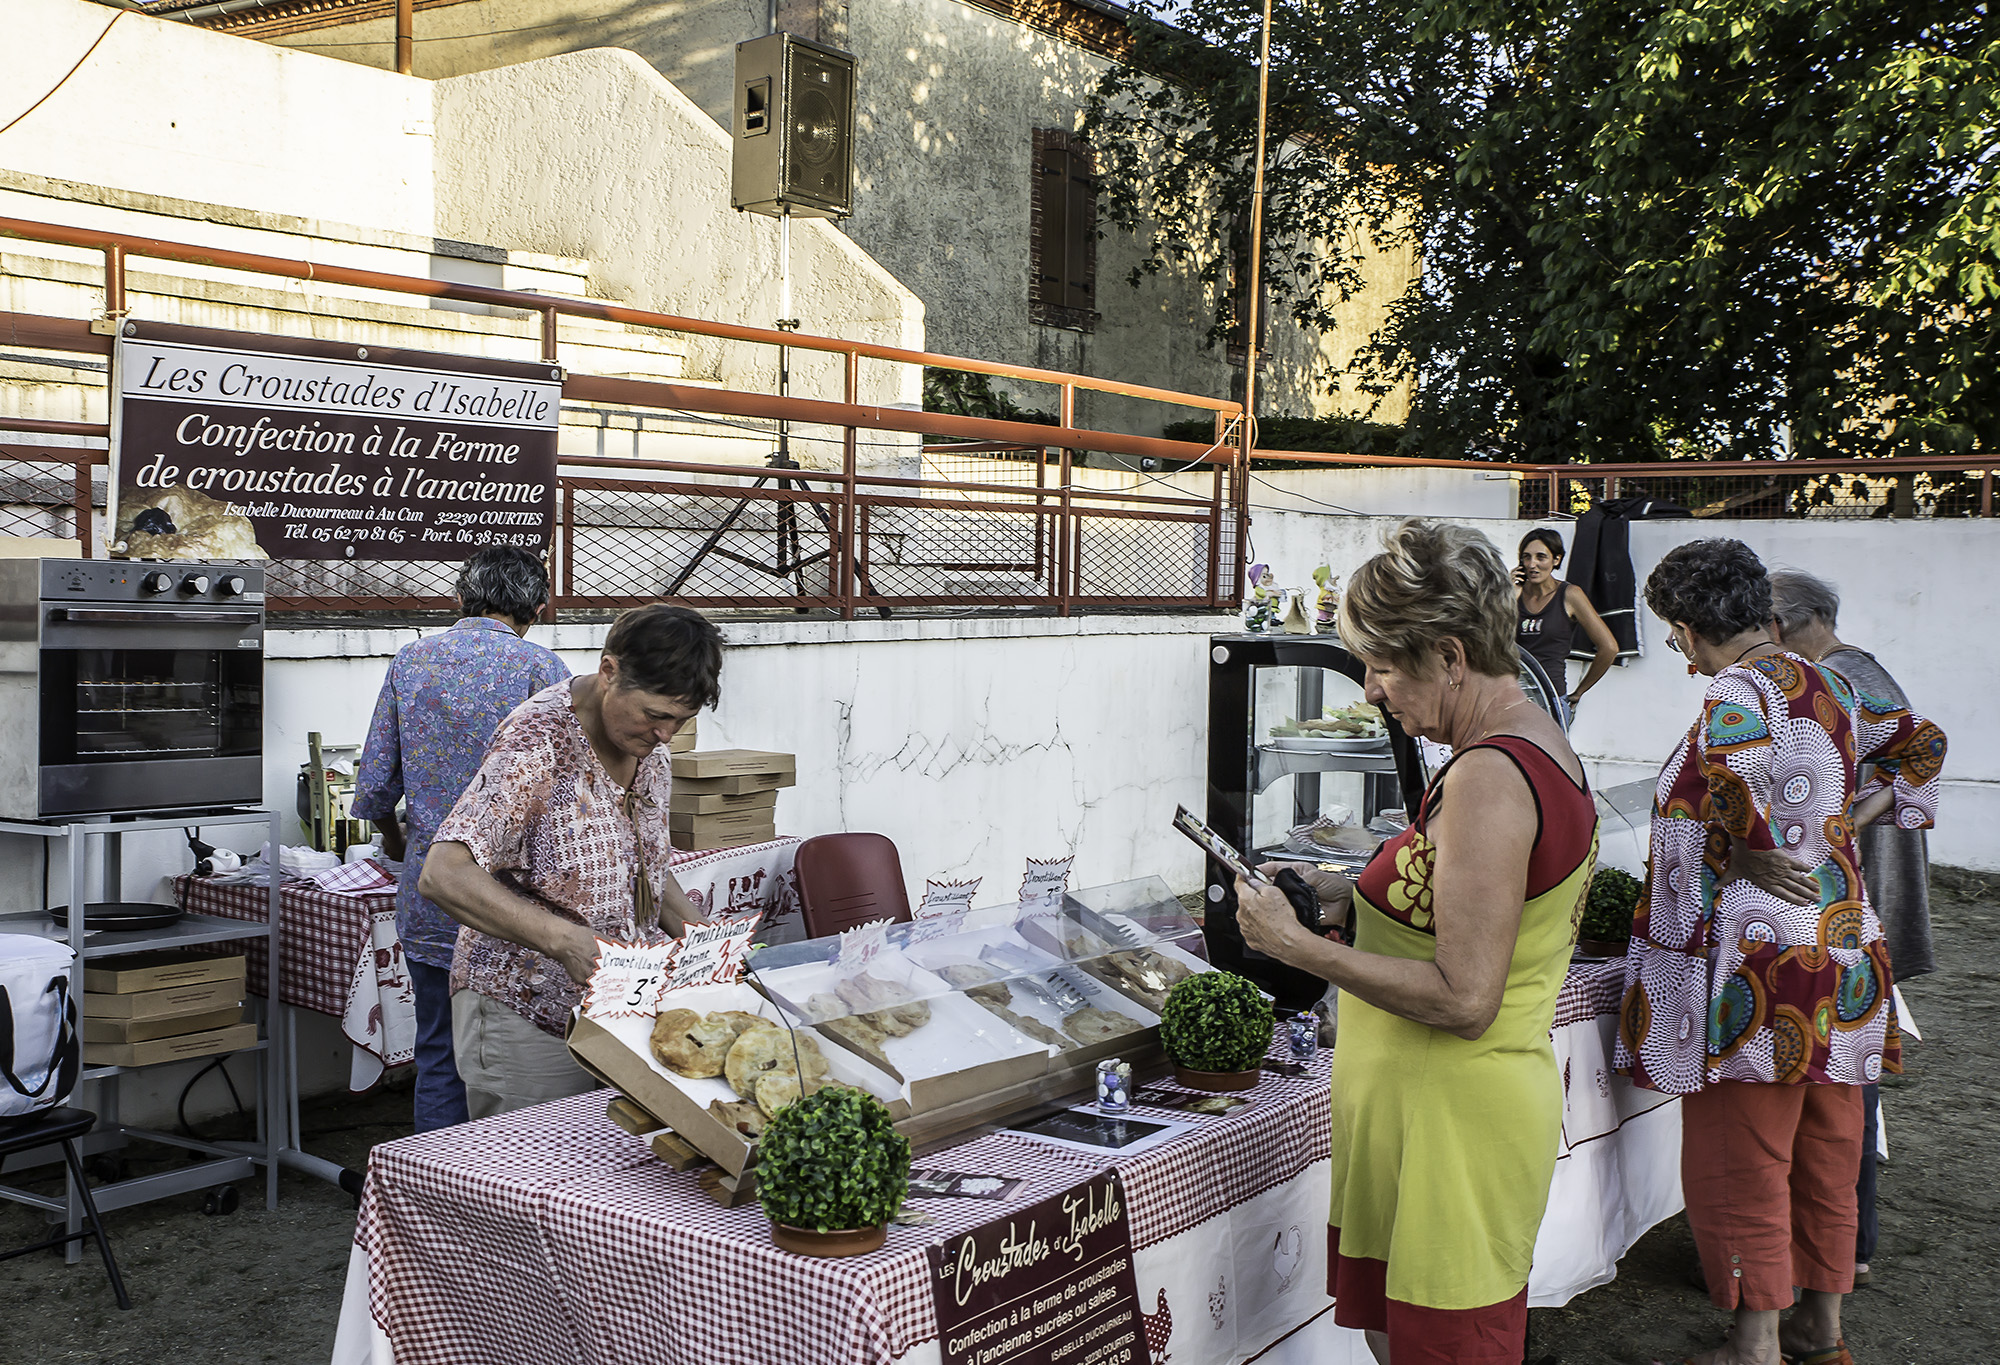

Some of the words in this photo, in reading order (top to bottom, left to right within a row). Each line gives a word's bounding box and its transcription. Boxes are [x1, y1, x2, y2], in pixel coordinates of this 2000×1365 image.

[139, 356, 207, 393] Les
[218, 363, 405, 409] Croustades
[413, 380, 549, 421] d'Isabelle
[176, 413, 356, 457] Confection
[361, 424, 384, 456] à
[388, 426, 423, 458] la
[425, 431, 520, 465] Ferme
[136, 453, 180, 489] de
[186, 462, 368, 497] croustades
[372, 466, 395, 498] à
[400, 466, 546, 504] l'ancienne
[222, 501, 280, 518] Isabelle
[280, 503, 364, 520] Ducourneau
[364, 505, 376, 520] à
[375, 506, 396, 521] Au
[397, 507, 424, 522] Cun
[434, 511, 478, 526] 32230
[479, 510, 544, 526] COURTIES
[284, 523, 309, 539] Tél.
[312, 526, 333, 543] 05
[333, 525, 351, 541] 62
[350, 527, 369, 543] 70
[370, 525, 386, 541] 81
[388, 526, 406, 544] 65
[421, 527, 453, 543] Port.
[456, 528, 474, 544] 06
[474, 529, 492, 546] 38
[492, 532, 508, 547] 53
[508, 532, 525, 547] 43
[525, 532, 542, 547] 50
[938, 1262, 955, 1279] LES
[955, 1219, 1051, 1307] Croustades
[948, 1313, 1008, 1356] Confection
[1010, 1309, 1018, 1327] à
[1020, 1306, 1031, 1322] la
[1032, 1291, 1063, 1316] ferme
[1064, 1283, 1077, 1300] de
[1078, 1258, 1127, 1293] croustades
[976, 1330, 1033, 1365] l'ancienne
[1034, 1309, 1074, 1339] sucrées
[1074, 1302, 1087, 1317] ou
[1088, 1285, 1117, 1310] salées
[1050, 1335, 1085, 1362] ISABELLE
[1085, 1309, 1132, 1343] DUCOURNEAU
[1102, 1331, 1136, 1356] COURTIES
[1119, 1348, 1131, 1363] 50
